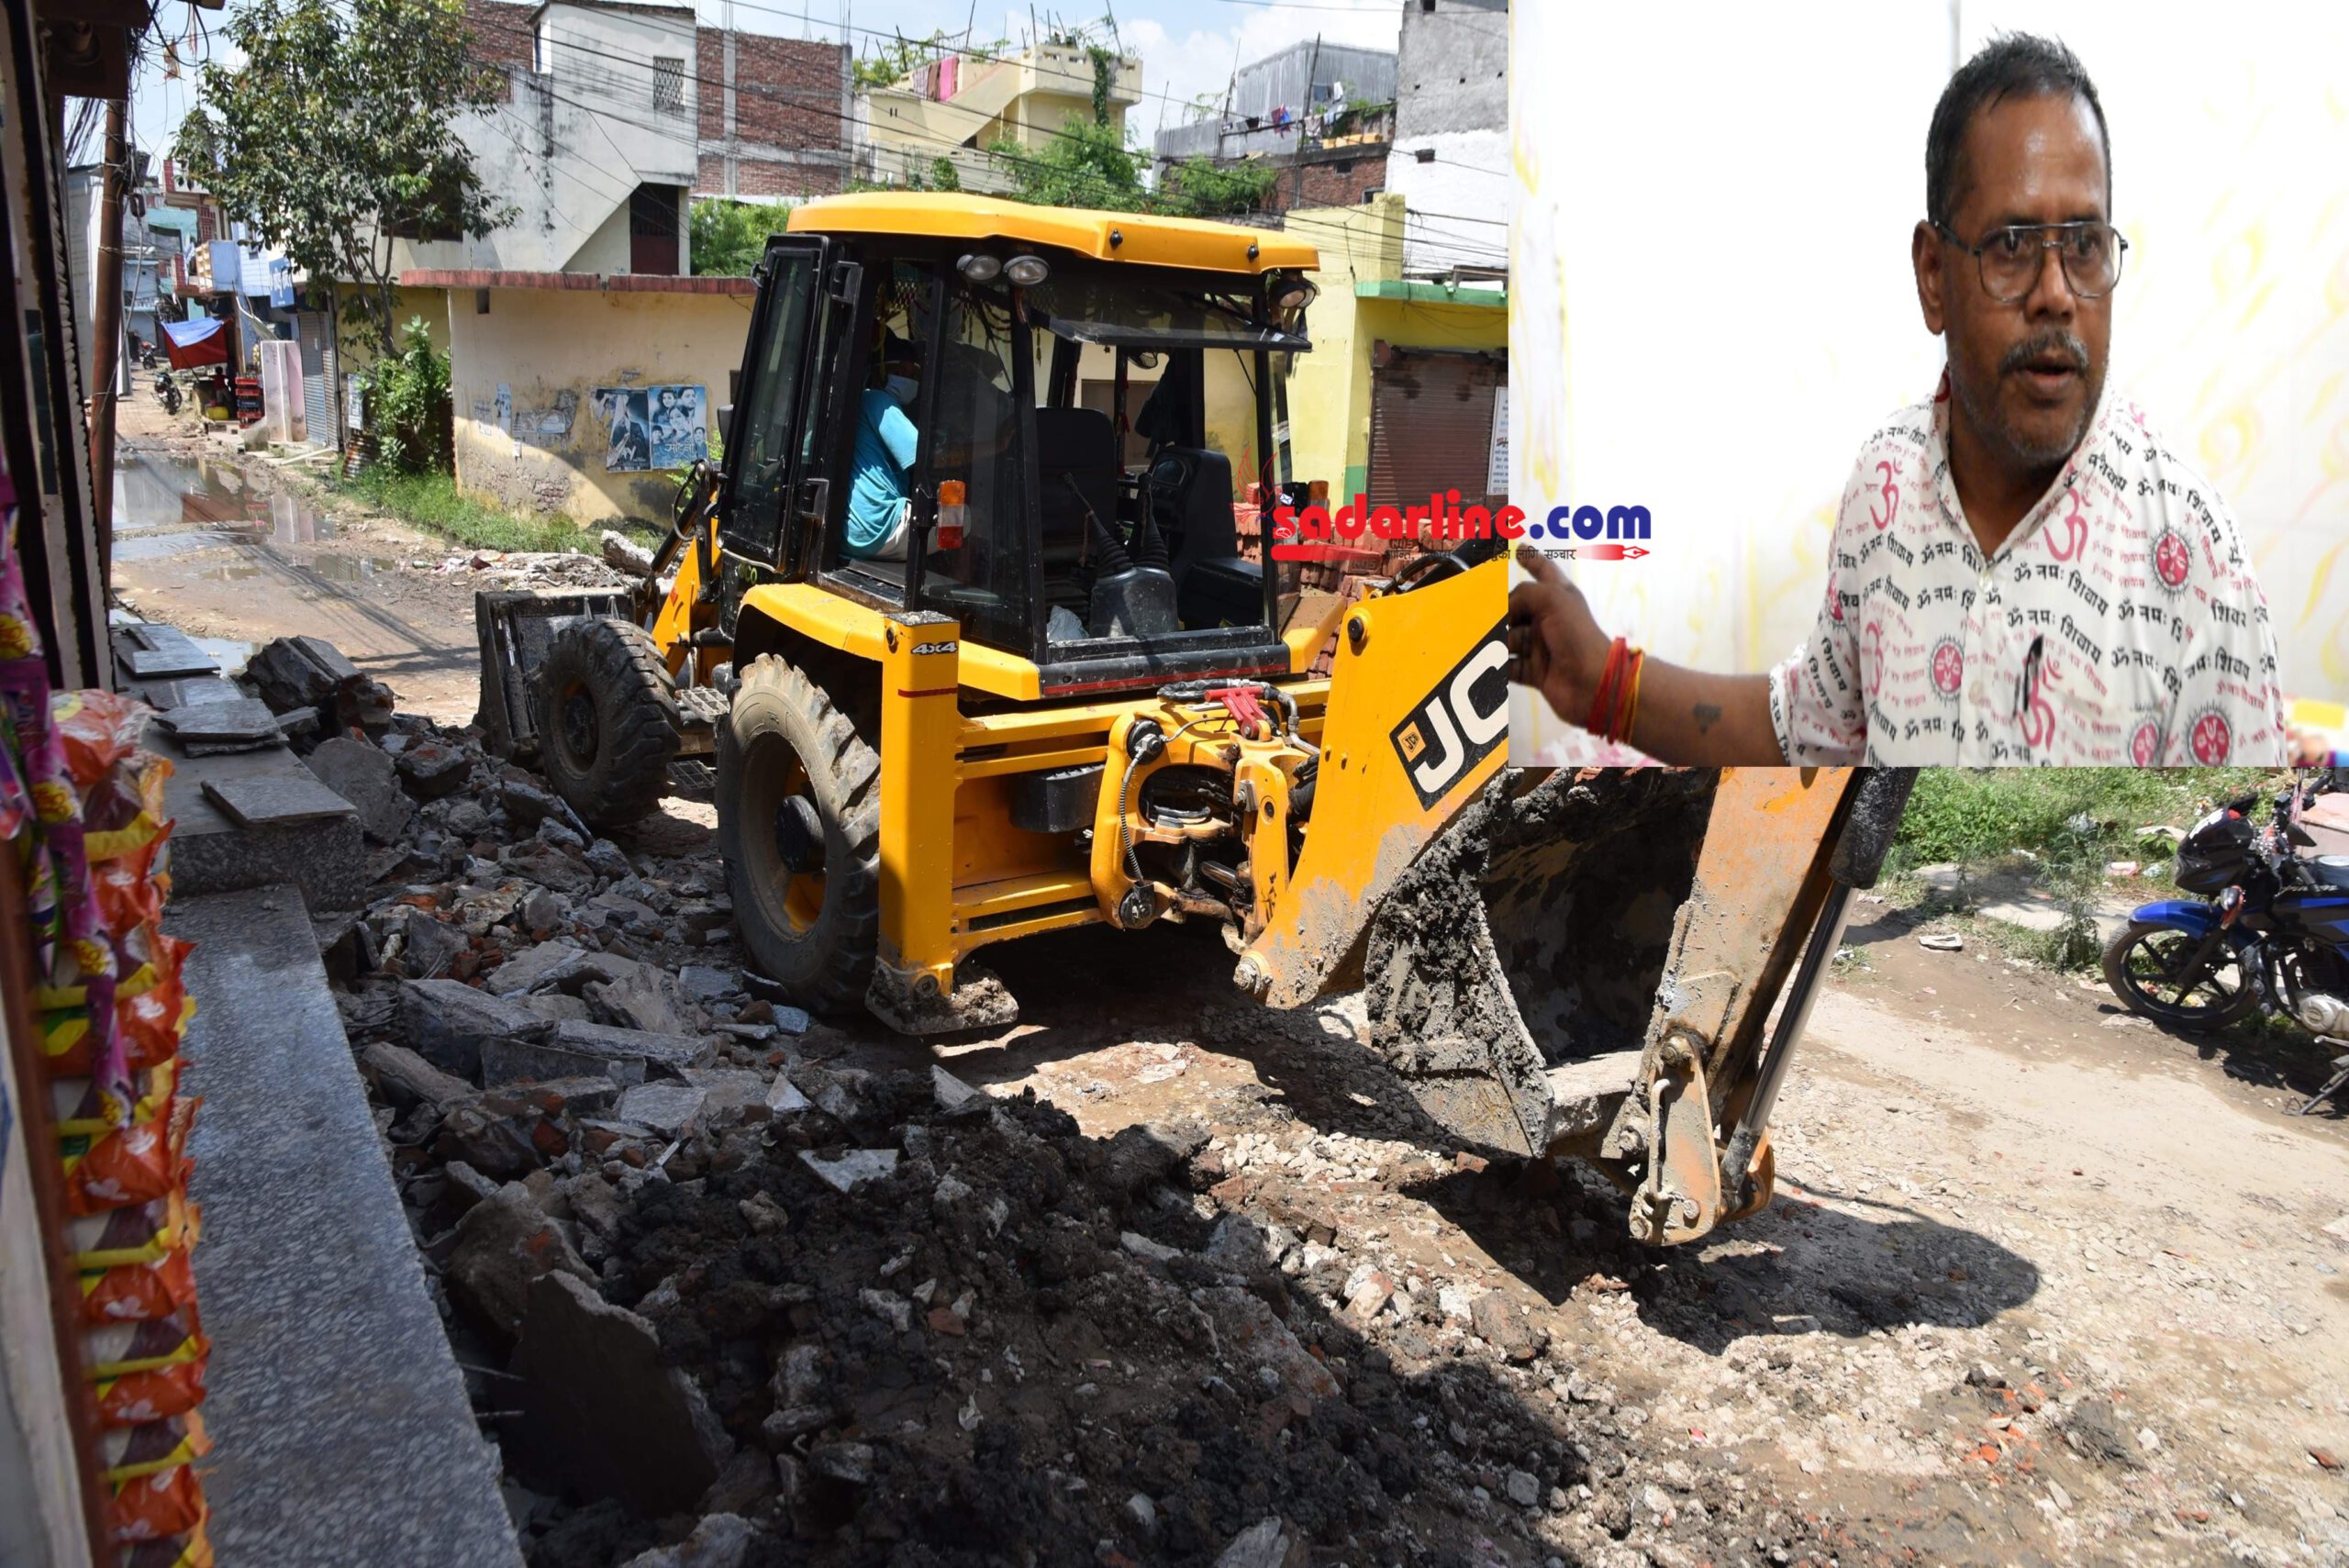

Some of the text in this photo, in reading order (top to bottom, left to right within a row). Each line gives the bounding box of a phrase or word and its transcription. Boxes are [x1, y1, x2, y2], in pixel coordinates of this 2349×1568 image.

[1934, 541, 1958, 558] नमः
[1934, 585, 1957, 602] नमः
[2035, 564, 2065, 580] नमः
[2067, 569, 2110, 617] शिवाय
[2138, 606, 2167, 625] नमः
[2027, 609, 2055, 626] नमः
[2060, 615, 2102, 665] शिवाय
[2132, 650, 2159, 673] नमः
[1405, 732, 1420, 751] JCB
